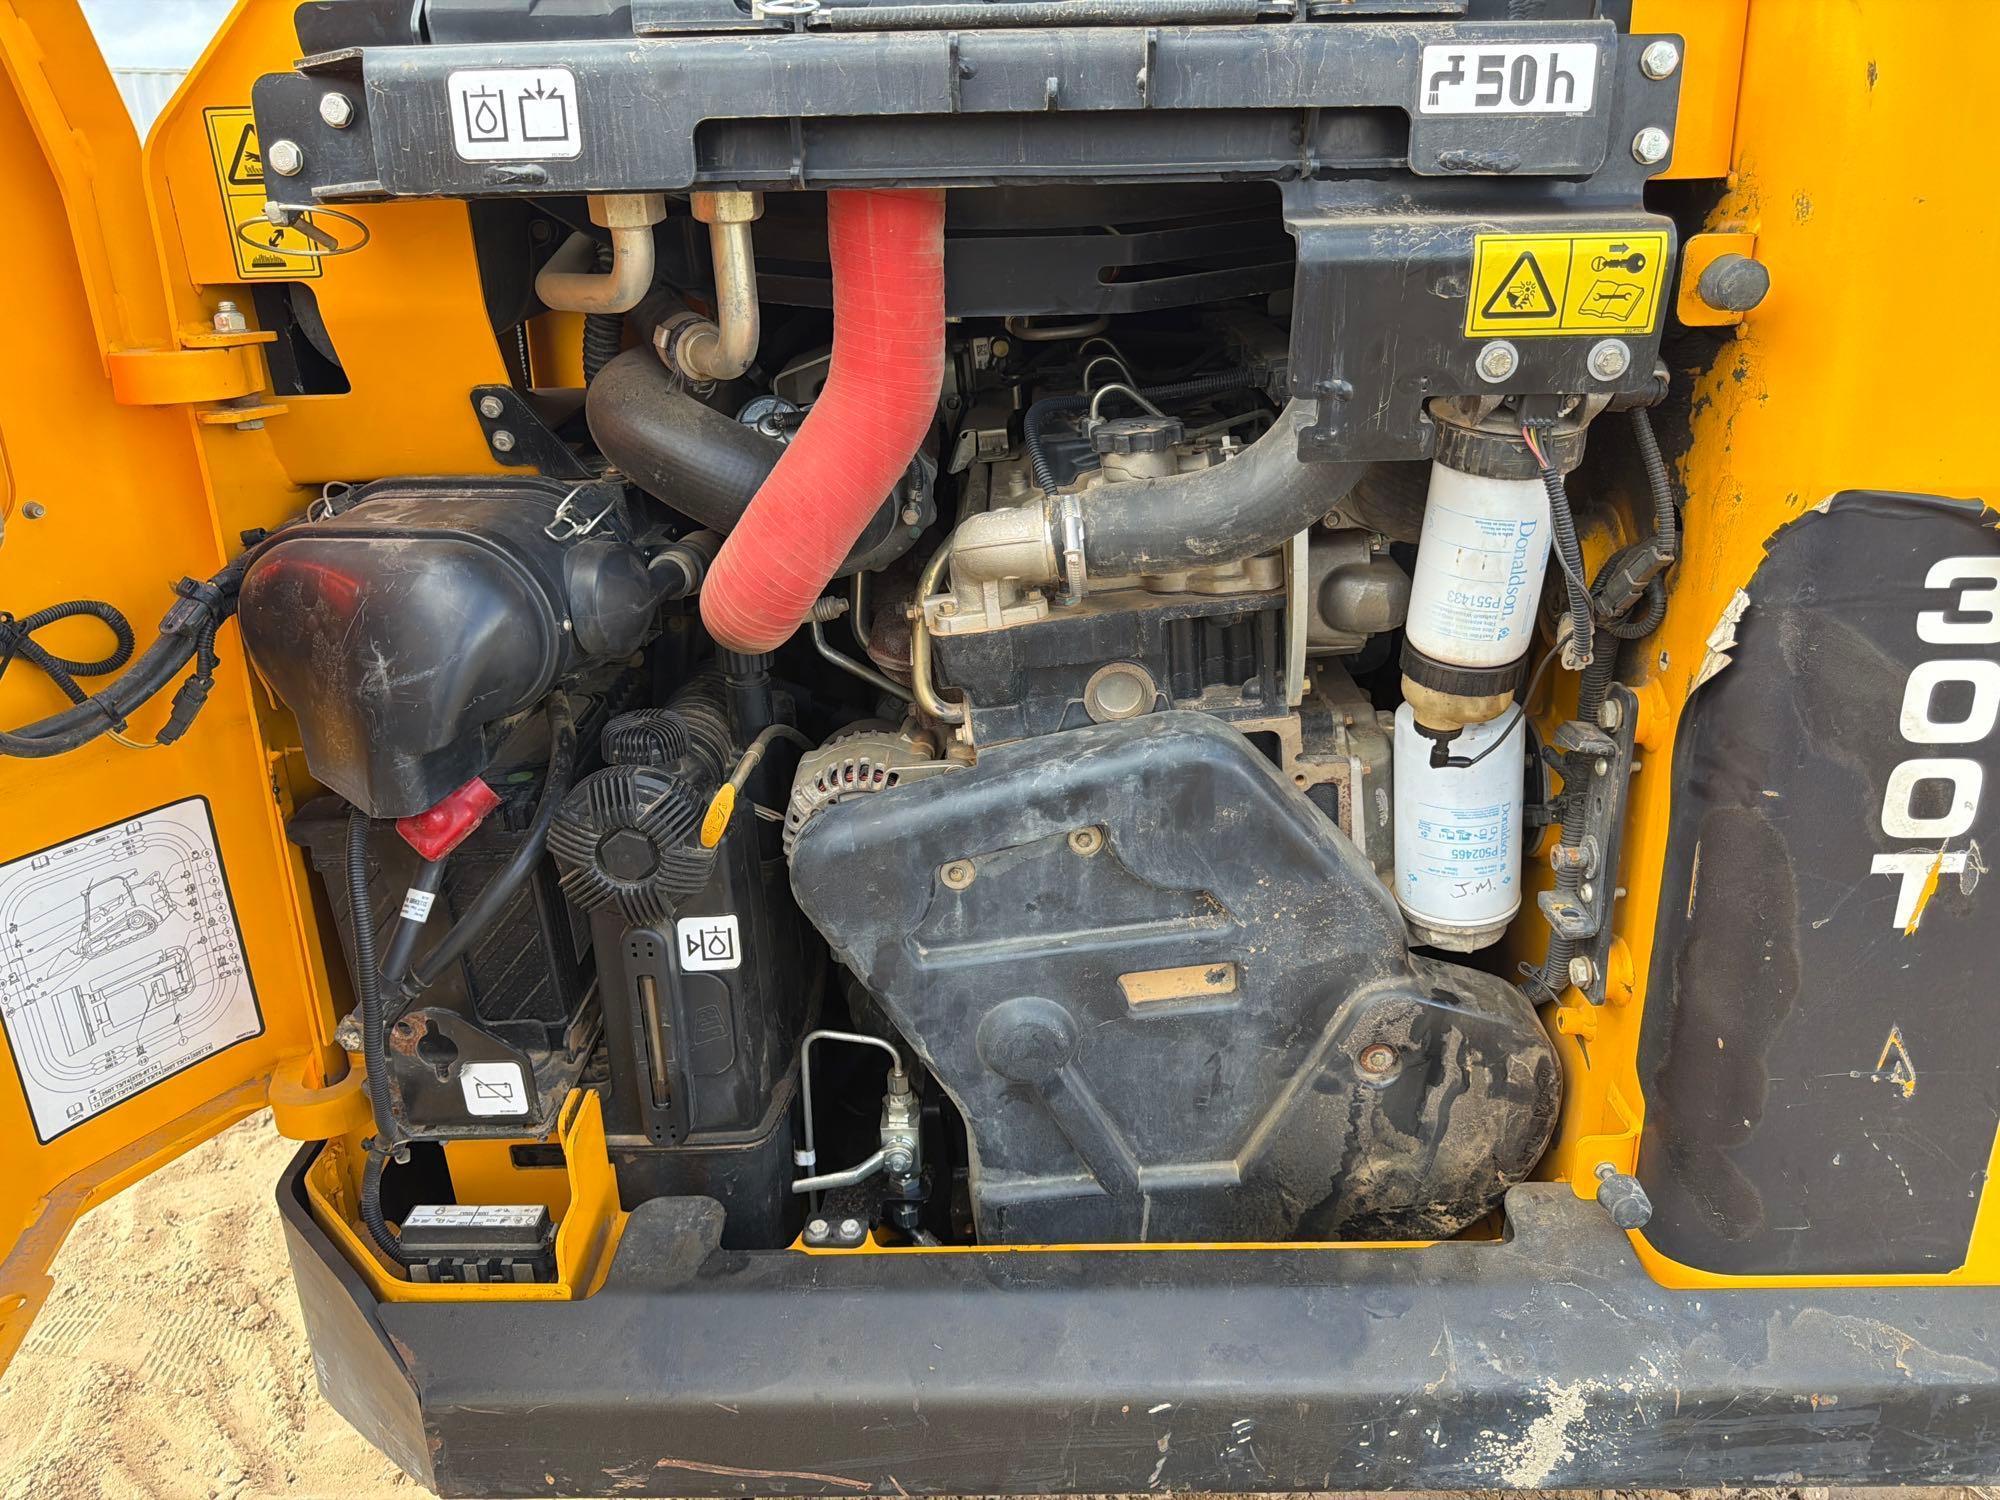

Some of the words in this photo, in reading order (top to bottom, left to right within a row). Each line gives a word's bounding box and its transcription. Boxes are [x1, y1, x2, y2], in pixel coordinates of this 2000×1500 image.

[1447, 590, 1502, 609] P551433
[1870, 554, 2000, 928] 300T
[1451, 845, 1498, 860] P502465
